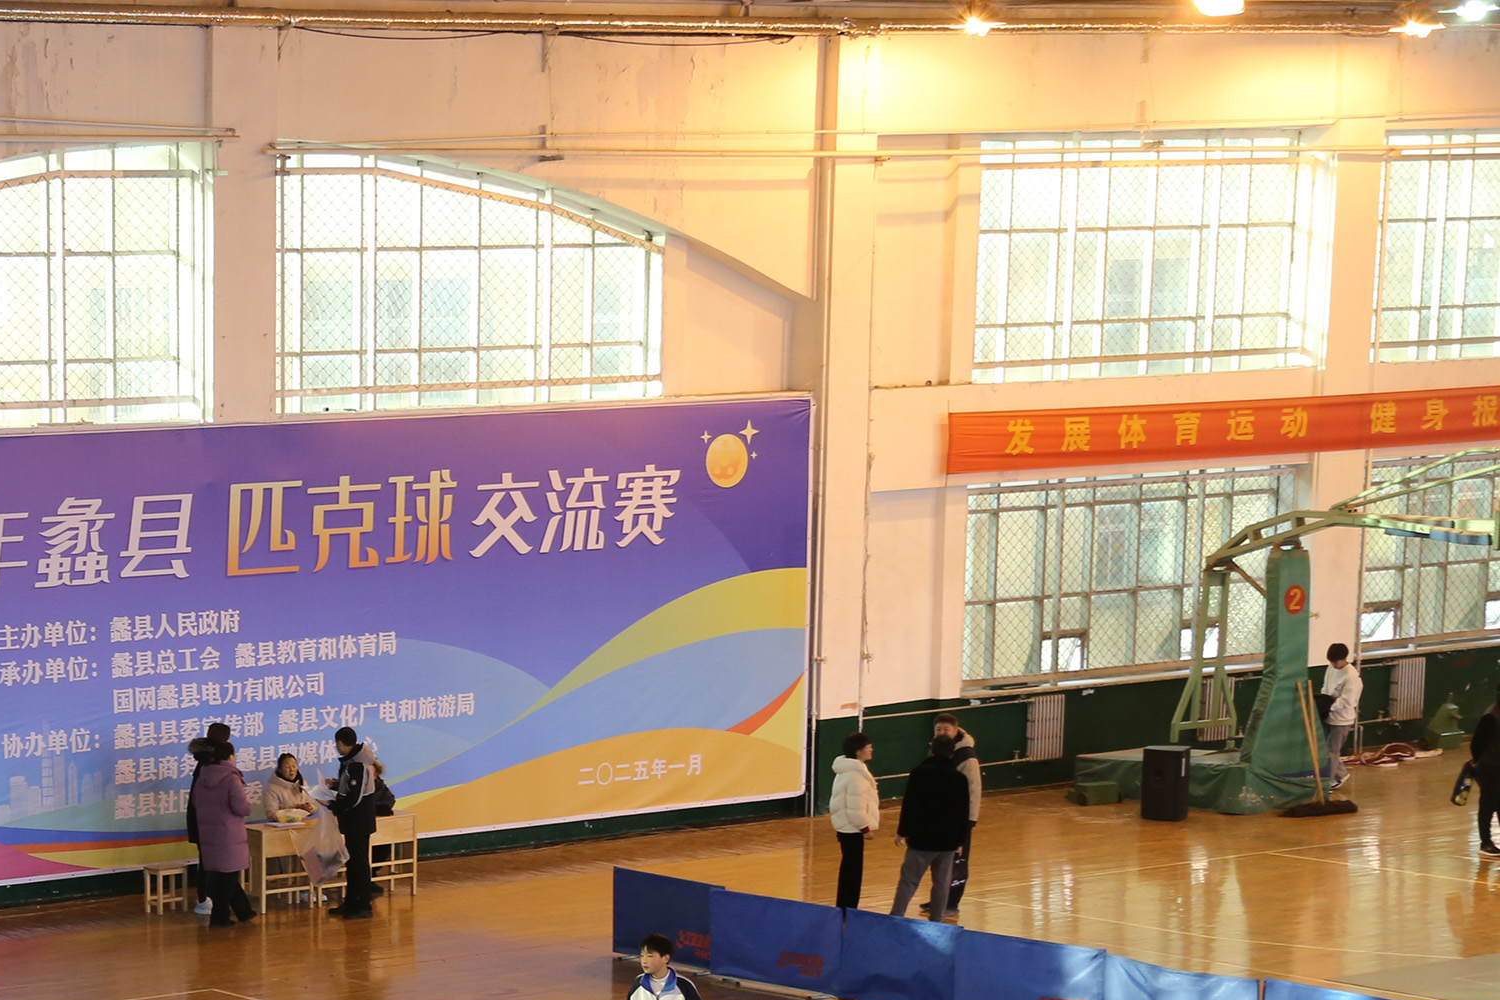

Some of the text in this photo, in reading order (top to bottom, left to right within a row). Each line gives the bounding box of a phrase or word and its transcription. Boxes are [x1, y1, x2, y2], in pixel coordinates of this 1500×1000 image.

[1005, 395, 1498, 455] 发展体育运动 健身报
[226, 464, 681, 579] 匹克球交流赛
[1289, 588, 1303, 611] 2
[110, 608, 240, 643] 蠡县人民政府
[111, 646, 220, 679] 蠡县总工会
[235, 631, 396, 670] 蠡县教育和体育局
[113, 671, 325, 714] 国网蠡县电力有限公司
[1, 728, 100, 759] 协办单位：
[278, 692, 475, 735] 蠡县文化广电和旅游局
[114, 753, 197, 785] 蠡县商务
